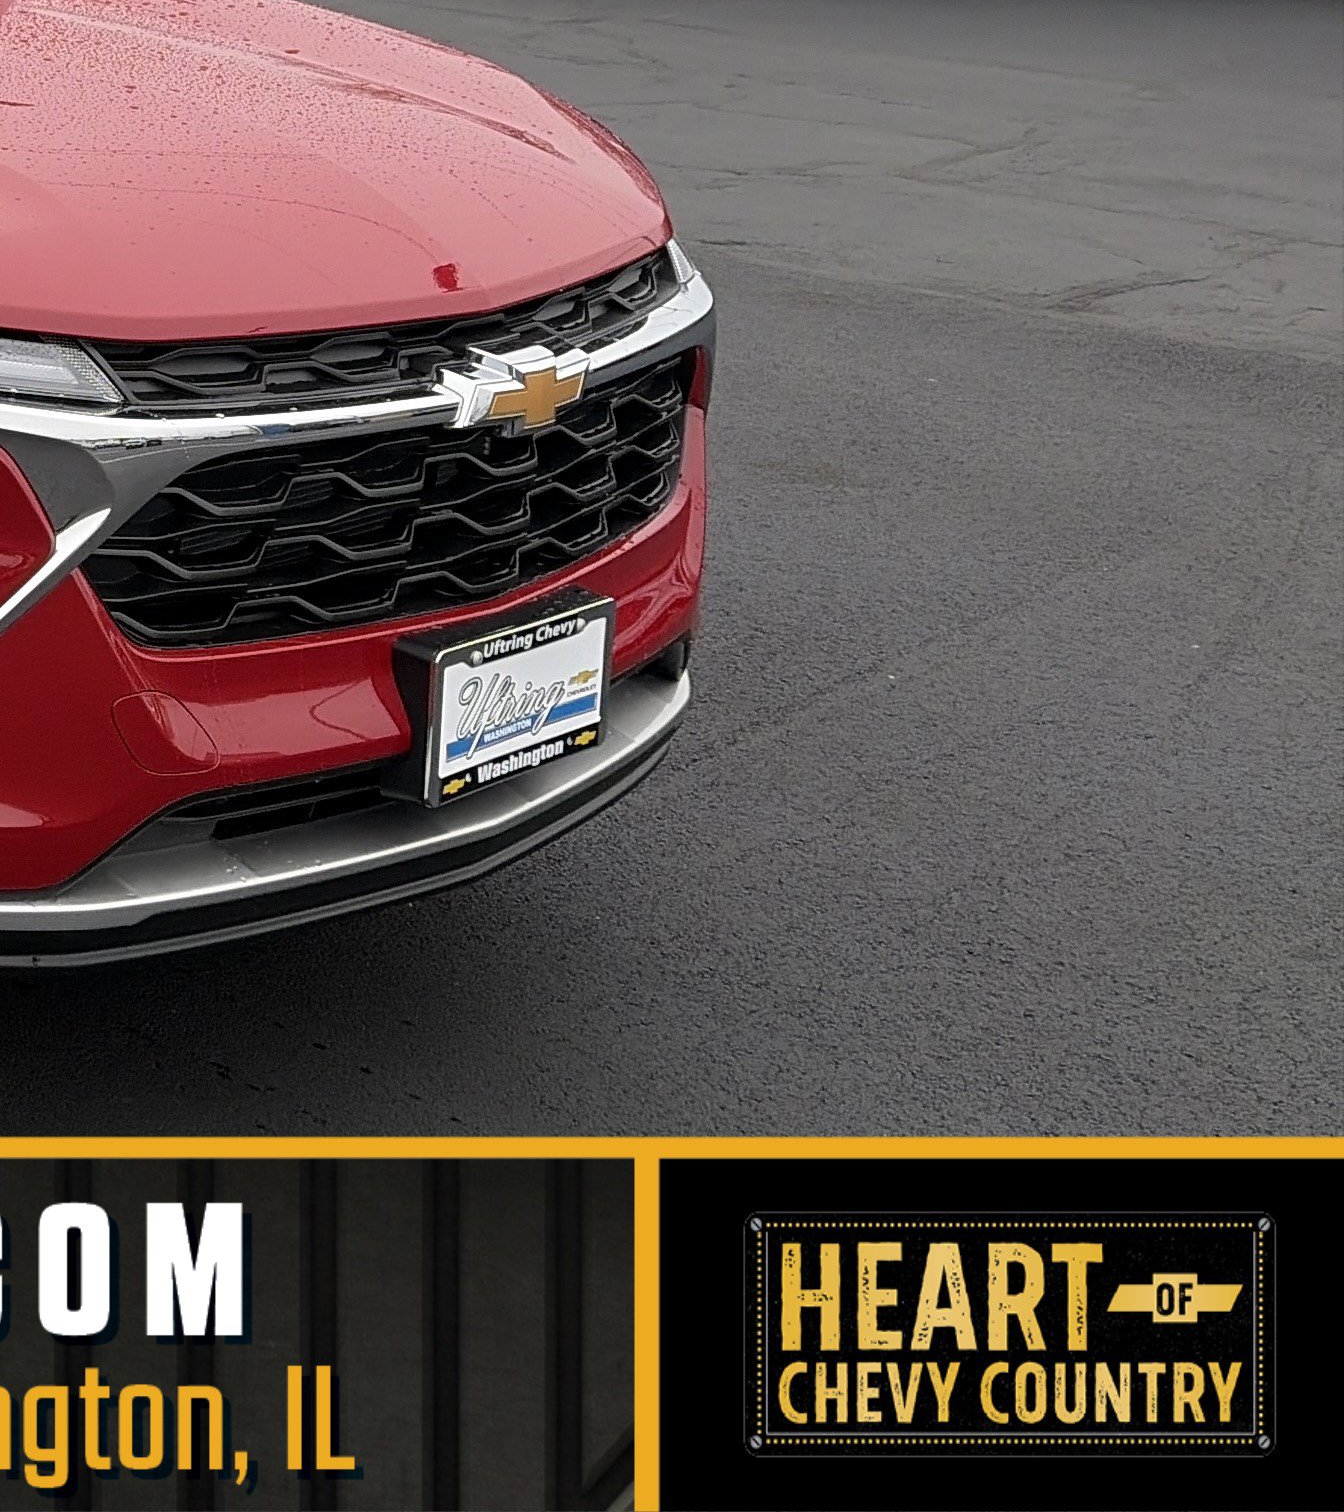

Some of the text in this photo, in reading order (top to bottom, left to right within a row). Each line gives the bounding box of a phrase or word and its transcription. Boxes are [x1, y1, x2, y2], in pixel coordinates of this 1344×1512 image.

[484, 620, 576, 659] Uftring Chevy
[458, 673, 565, 759] Uftring
[484, 719, 532, 743] WASHINGTON
[477, 739, 565, 784] Washington
